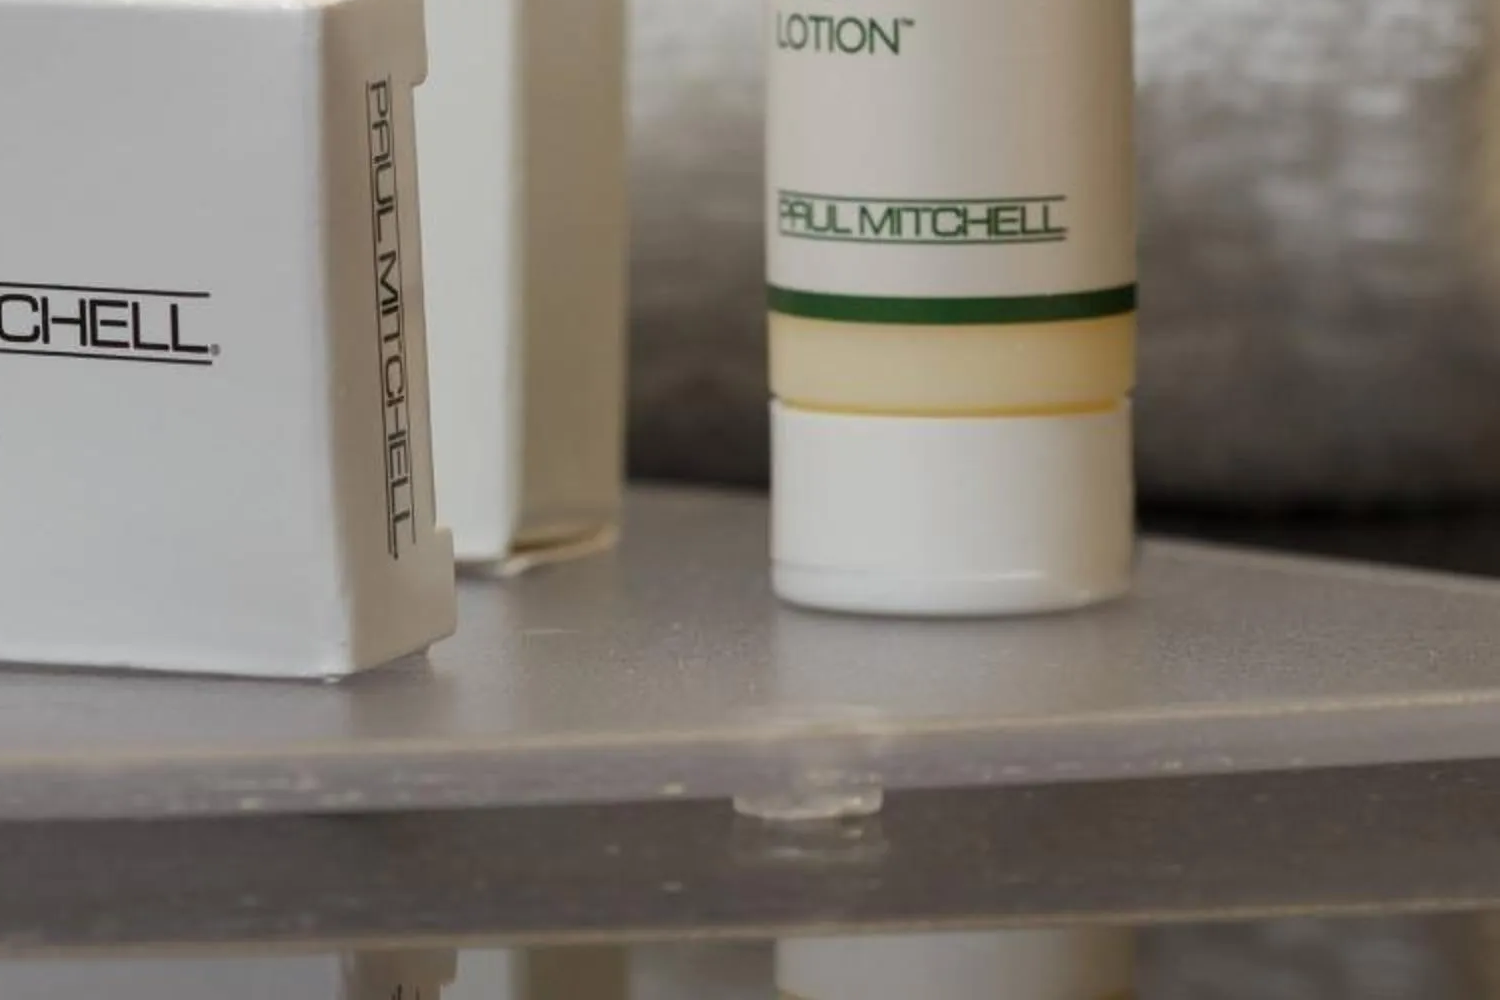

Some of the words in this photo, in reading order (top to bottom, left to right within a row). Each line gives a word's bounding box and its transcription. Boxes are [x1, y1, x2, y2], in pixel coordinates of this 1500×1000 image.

[369, 80, 393, 242] PAUL
[779, 199, 852, 234] PAUL
[859, 205, 1067, 238] MITCHELL
[377, 251, 411, 559] MITCHELL
